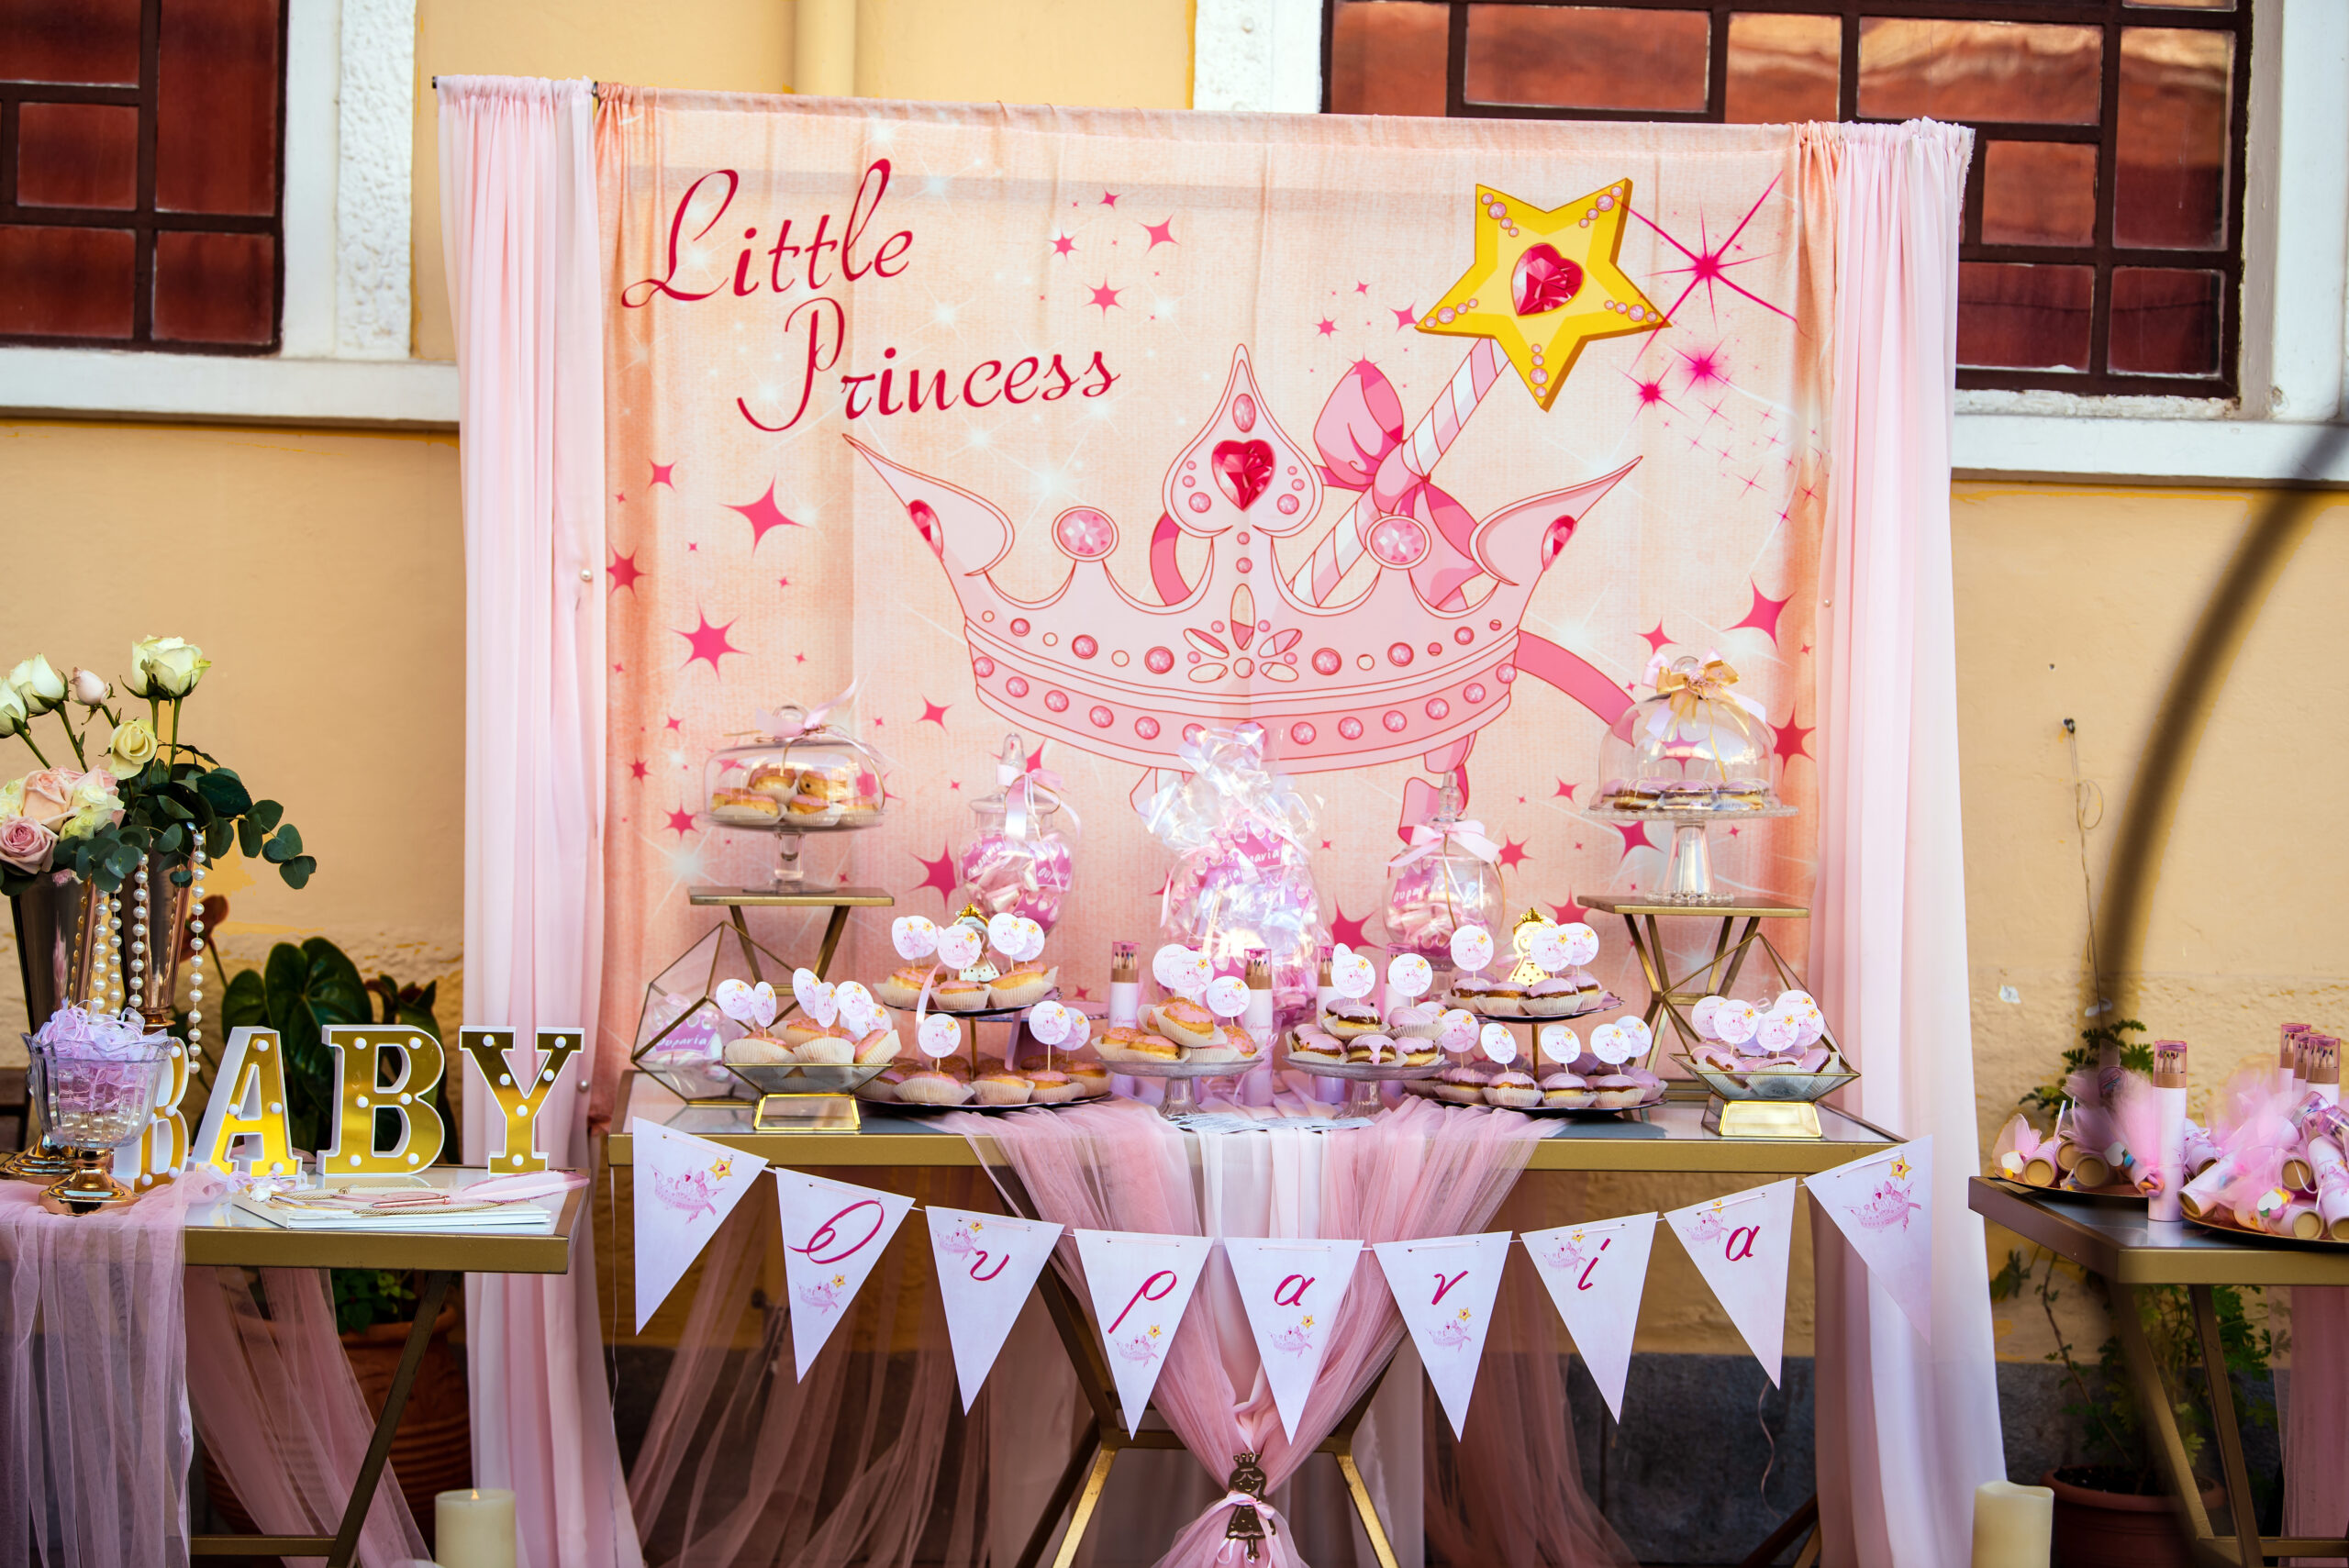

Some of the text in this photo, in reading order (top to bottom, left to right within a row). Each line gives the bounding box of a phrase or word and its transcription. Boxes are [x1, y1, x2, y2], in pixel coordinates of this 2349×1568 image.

[621, 158, 914, 308] Little
[737, 296, 1121, 432] Princess
[114, 1024, 584, 1193] BABY
